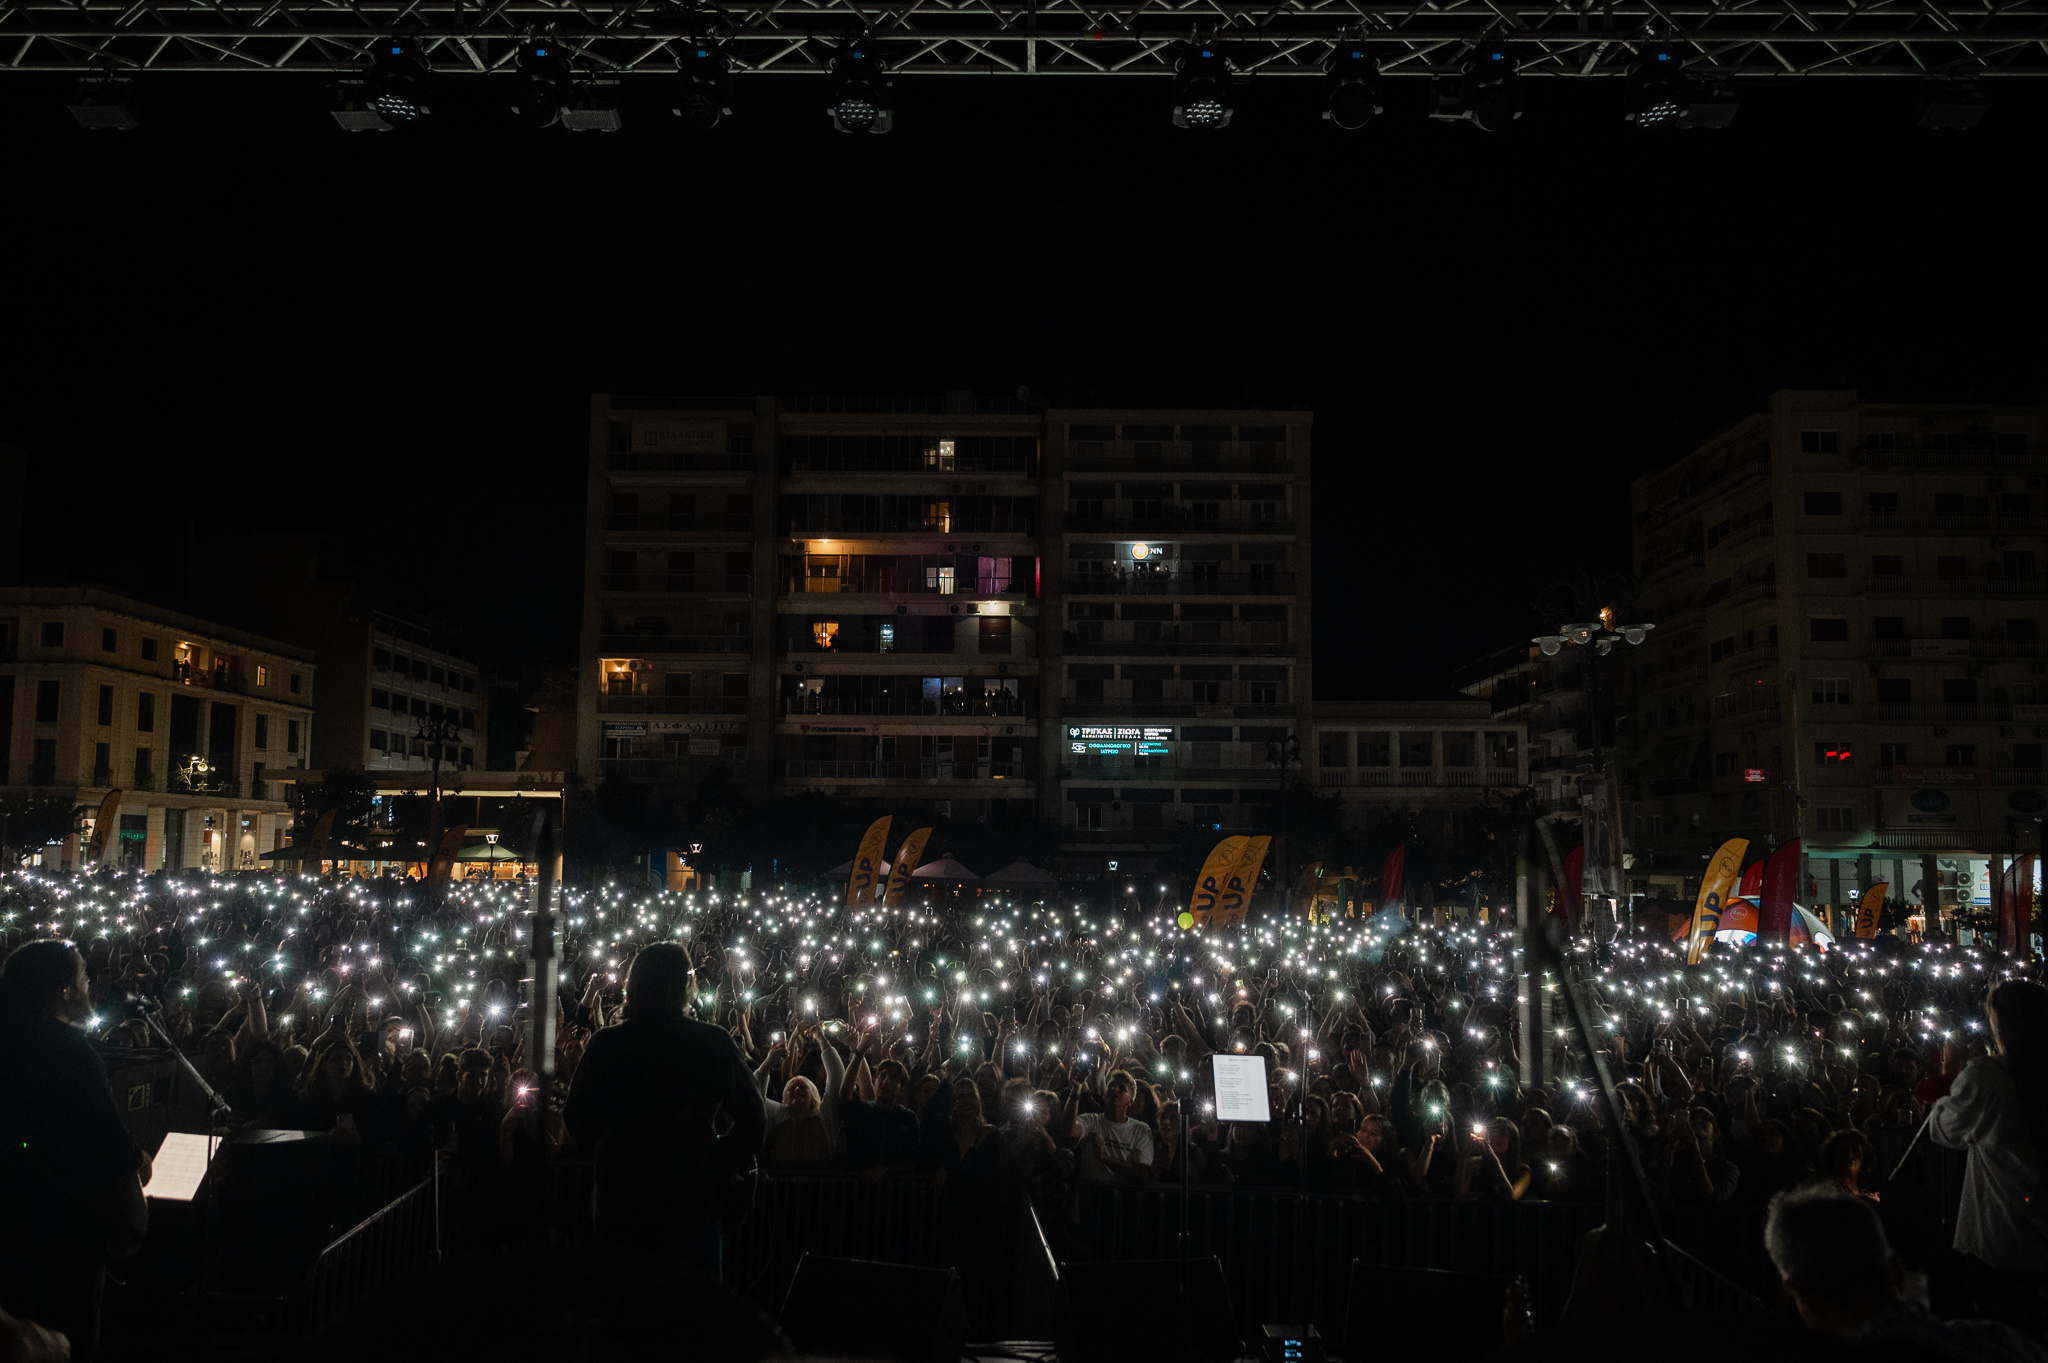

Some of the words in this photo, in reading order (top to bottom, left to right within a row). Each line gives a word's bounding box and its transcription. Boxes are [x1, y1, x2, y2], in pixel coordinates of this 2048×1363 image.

[1150, 547, 1163, 555] NN
[855, 857, 873, 890] UP
[892, 863, 911, 892] UP
[1197, 876, 1220, 911] UP
[1222, 876, 1246, 910] UP
[1700, 891, 1724, 938] UP
[1860, 908, 1875, 929] UP
